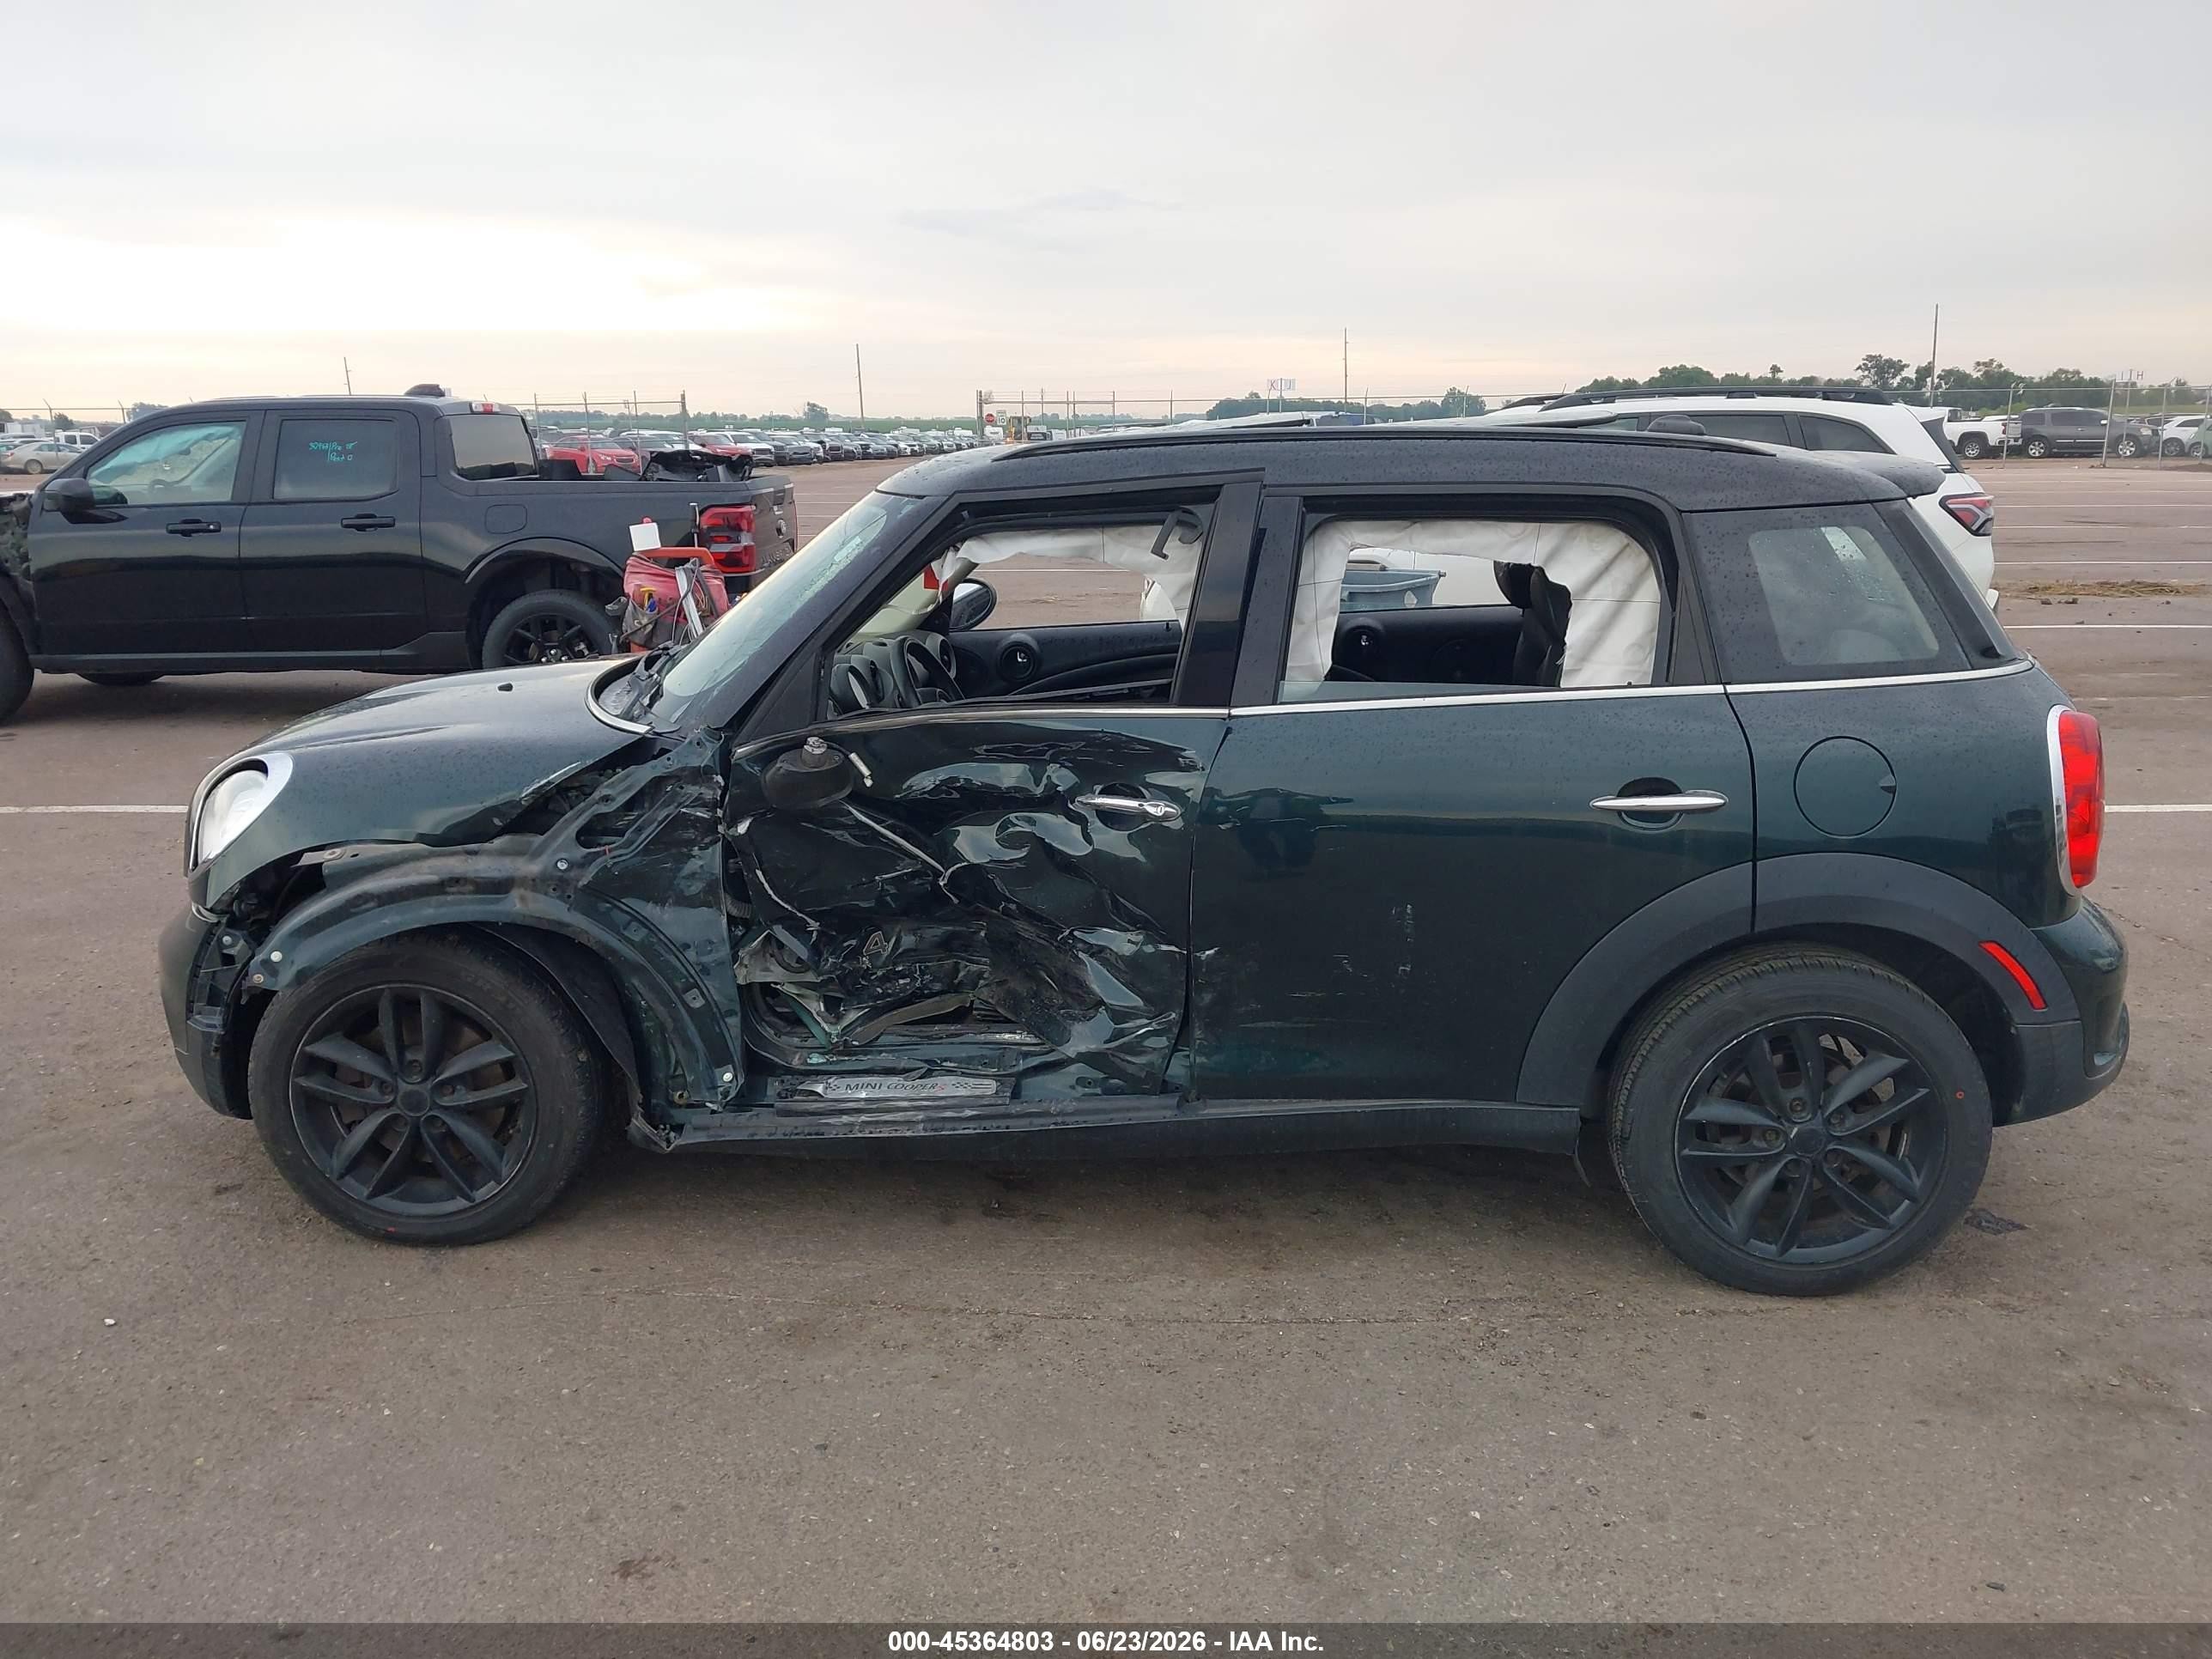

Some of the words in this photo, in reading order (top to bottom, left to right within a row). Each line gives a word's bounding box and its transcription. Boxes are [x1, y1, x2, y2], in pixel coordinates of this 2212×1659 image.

[1270, 379, 1277, 391] K
[845, 1082, 883, 1091] MINI
[886, 1082, 939, 1091] COOPER
